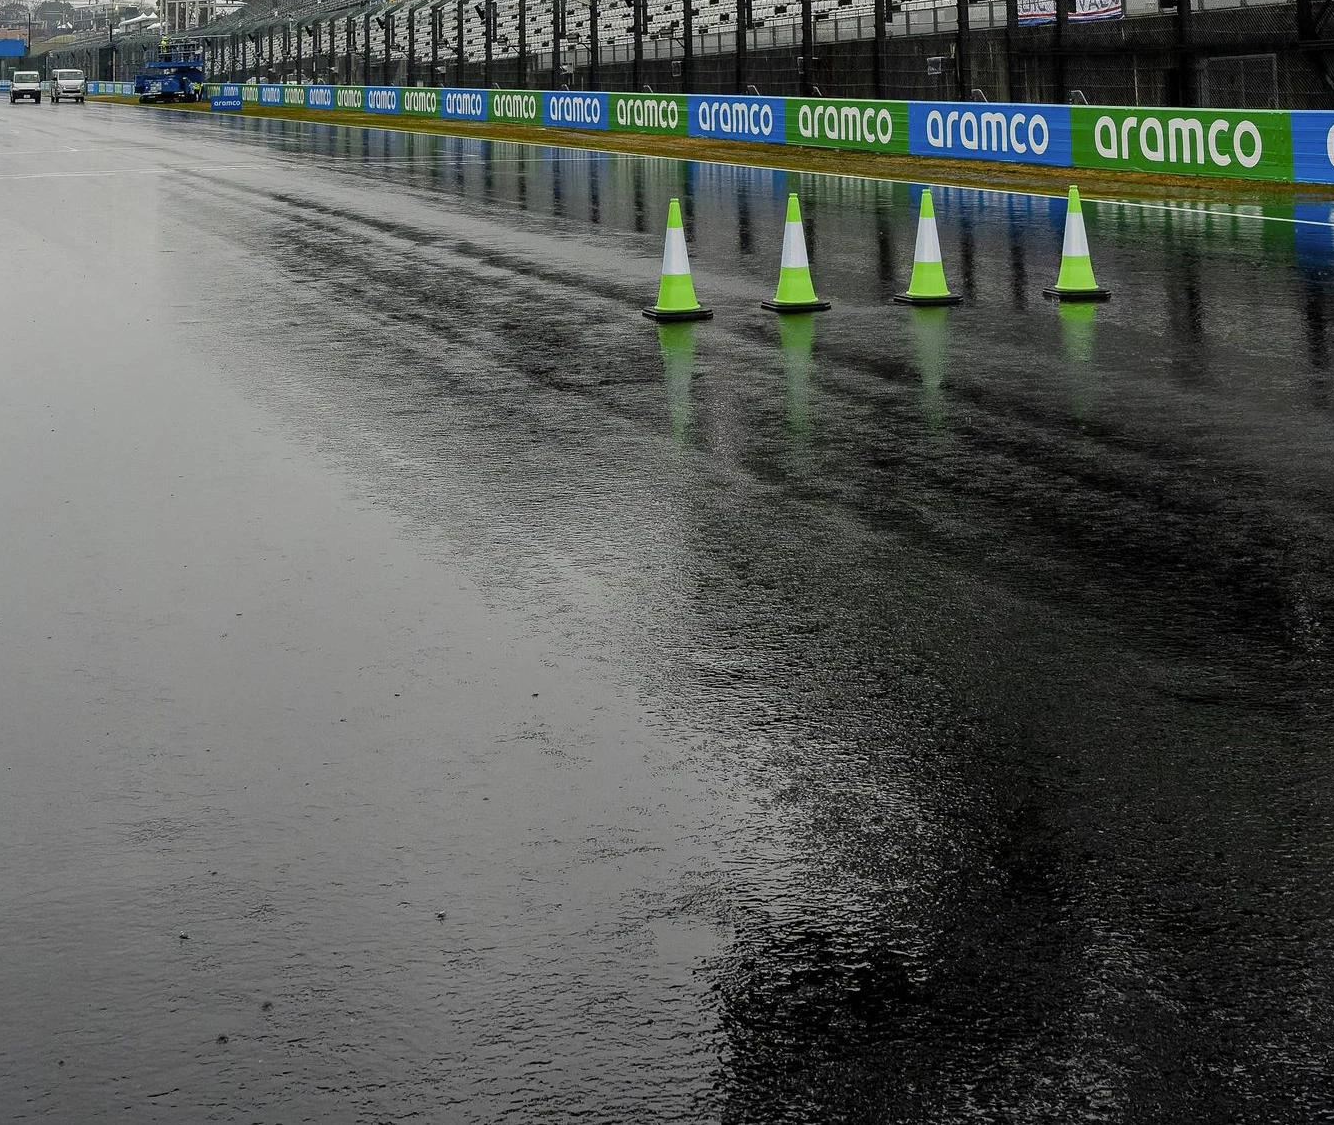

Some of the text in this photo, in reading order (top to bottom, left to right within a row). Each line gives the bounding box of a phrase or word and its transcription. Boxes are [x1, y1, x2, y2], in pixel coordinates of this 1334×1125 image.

[284, 88, 305, 104] aramco
[309, 88, 331, 105] aramco
[337, 89, 362, 108] aramco
[368, 89, 396, 110] aramco
[404, 91, 437, 113] aramco
[446, 92, 482, 116] aramco
[493, 94, 536, 119] aramco
[549, 96, 600, 124] aramco
[617, 98, 678, 129] aramco
[698, 101, 773, 136] aramco
[798, 104, 893, 144] aramco
[925, 109, 1049, 155] aramco
[1094, 116, 1263, 169] aramco
